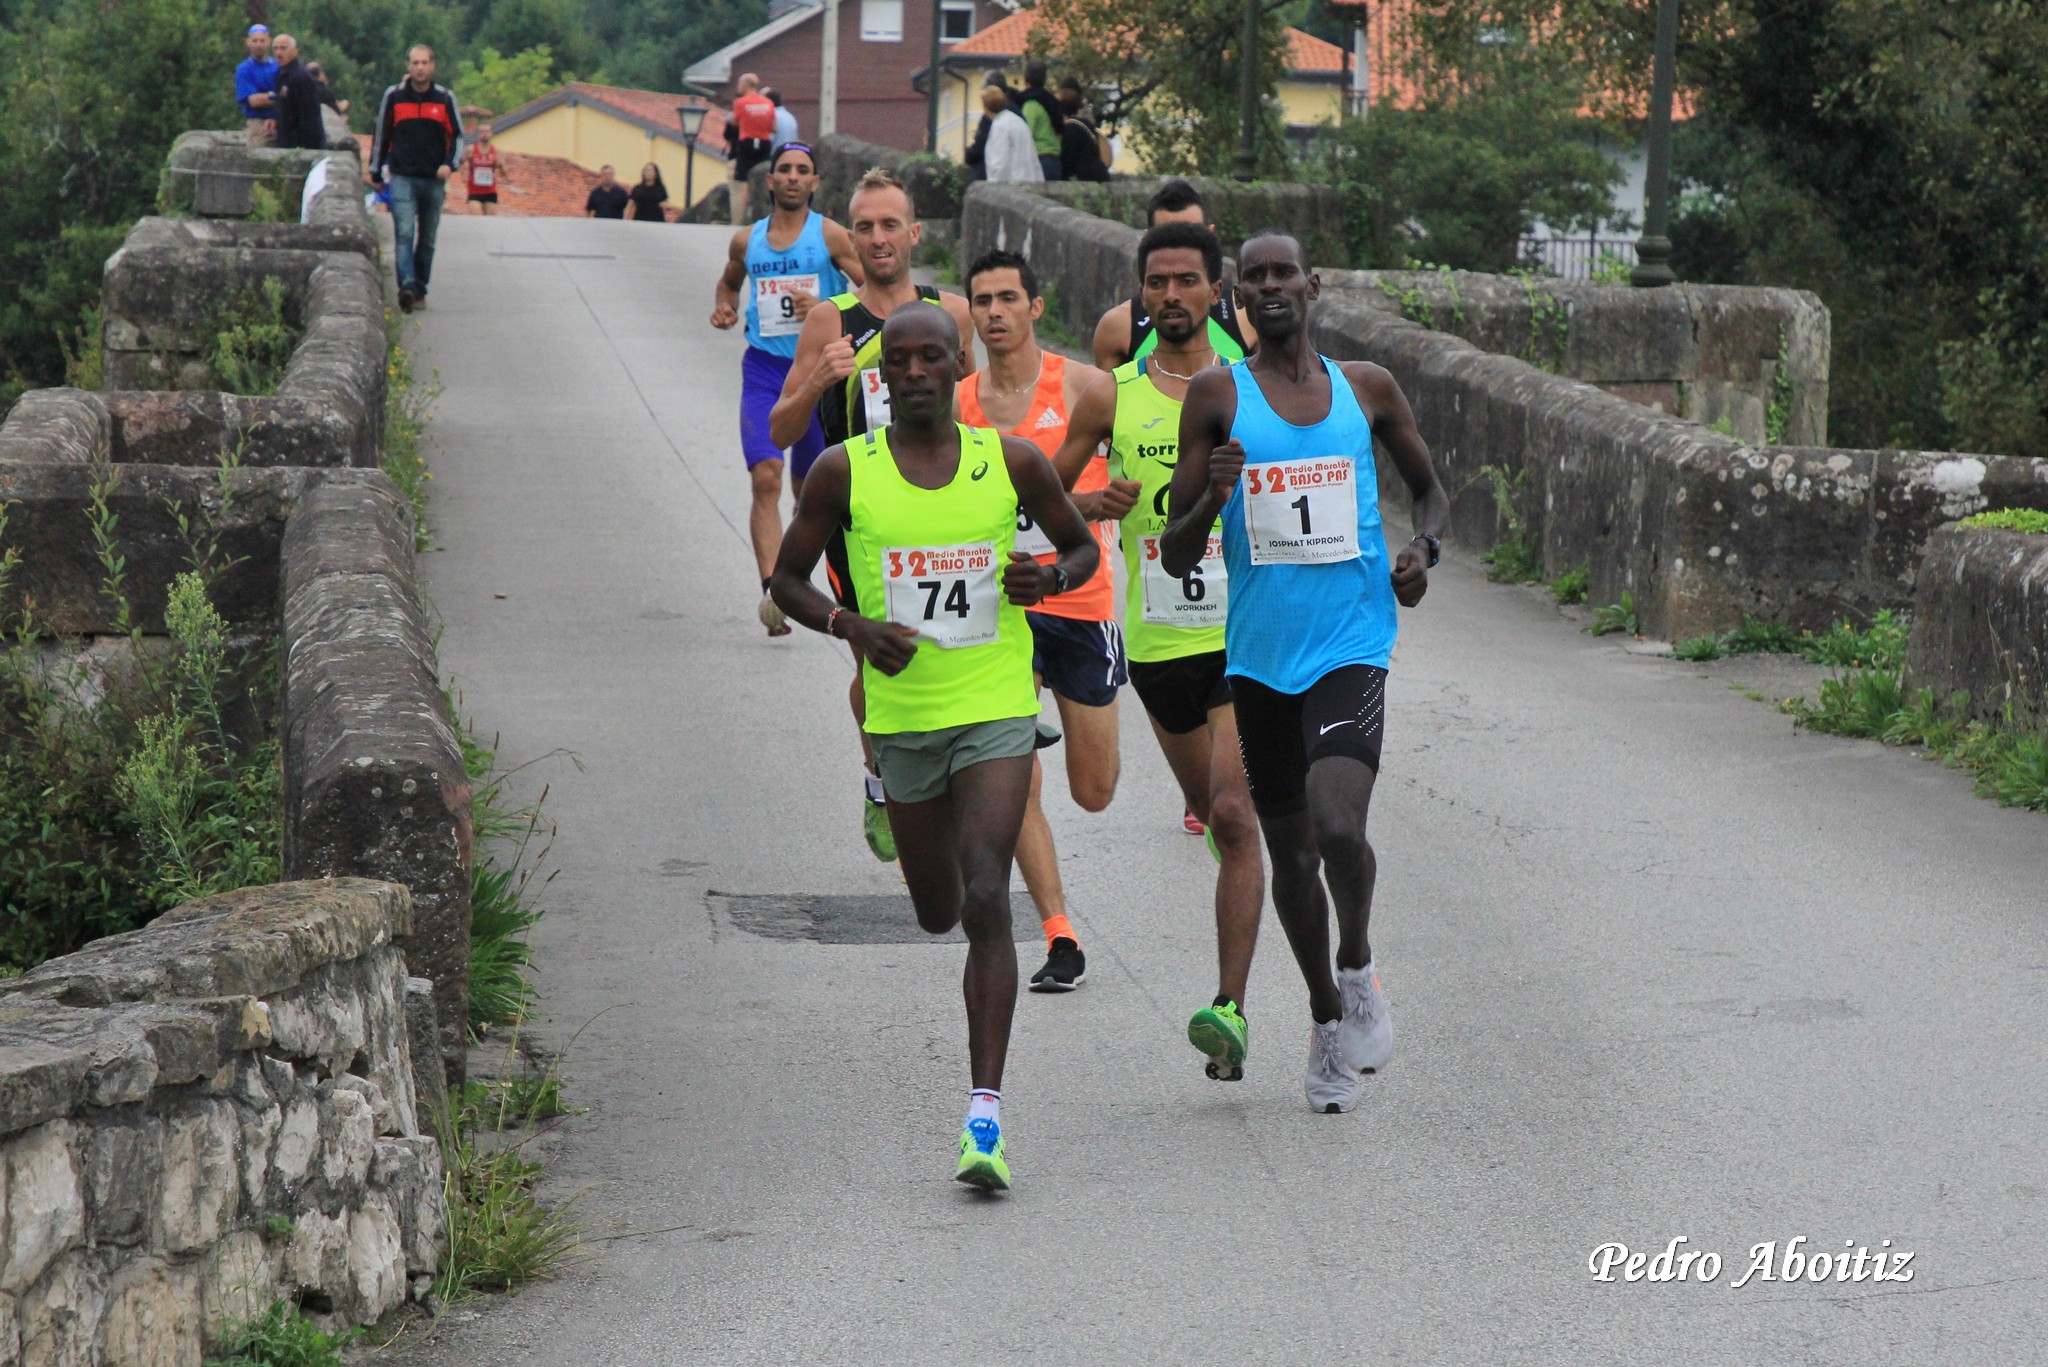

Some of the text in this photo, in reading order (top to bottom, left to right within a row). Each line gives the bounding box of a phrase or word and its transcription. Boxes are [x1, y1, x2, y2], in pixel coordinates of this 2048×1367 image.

[752, 257, 799, 274] nerja
[781, 296, 794, 318] 9
[1285, 461, 1351, 474] Medio Maratón
[1290, 469, 1348, 486] BAJO PAS
[1291, 495, 1312, 535] 1
[1269, 536, 1345, 548] JOSPHAT KIPRONO
[927, 548, 992, 559] Medio Maratón
[932, 556, 989, 570] BAJO PAS
[1182, 566, 1206, 602] 6
[917, 579, 970, 620] 74
